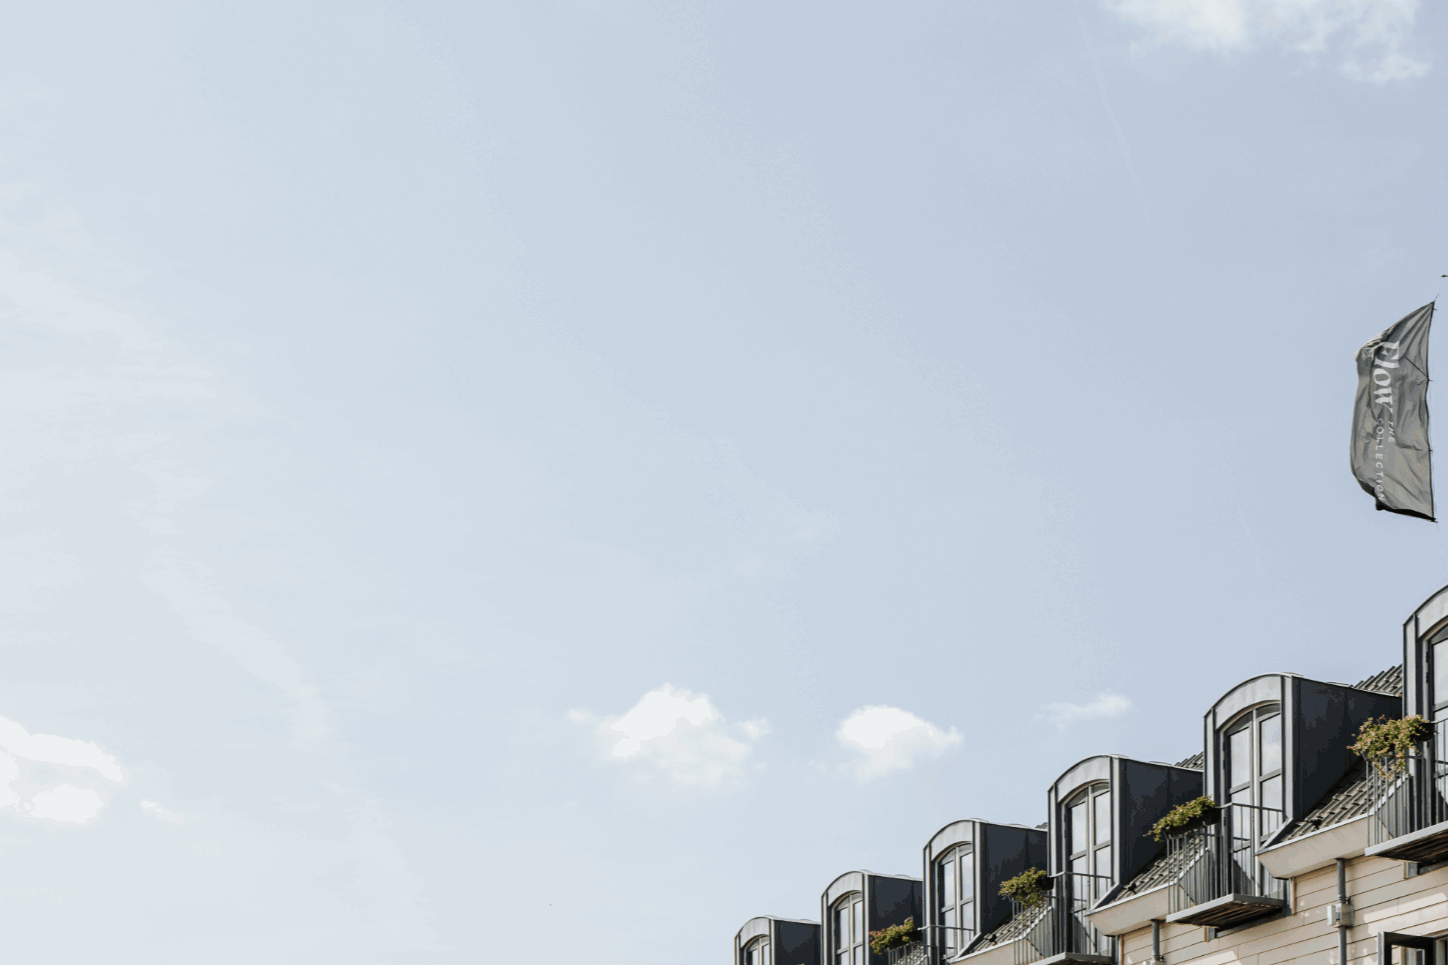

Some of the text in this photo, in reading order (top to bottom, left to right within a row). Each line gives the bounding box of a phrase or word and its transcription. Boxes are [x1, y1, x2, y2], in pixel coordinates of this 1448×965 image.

[1373, 340, 1400, 414] Flow
[1375, 418, 1385, 502] COLLECTION
[1388, 420, 1396, 444] THE
